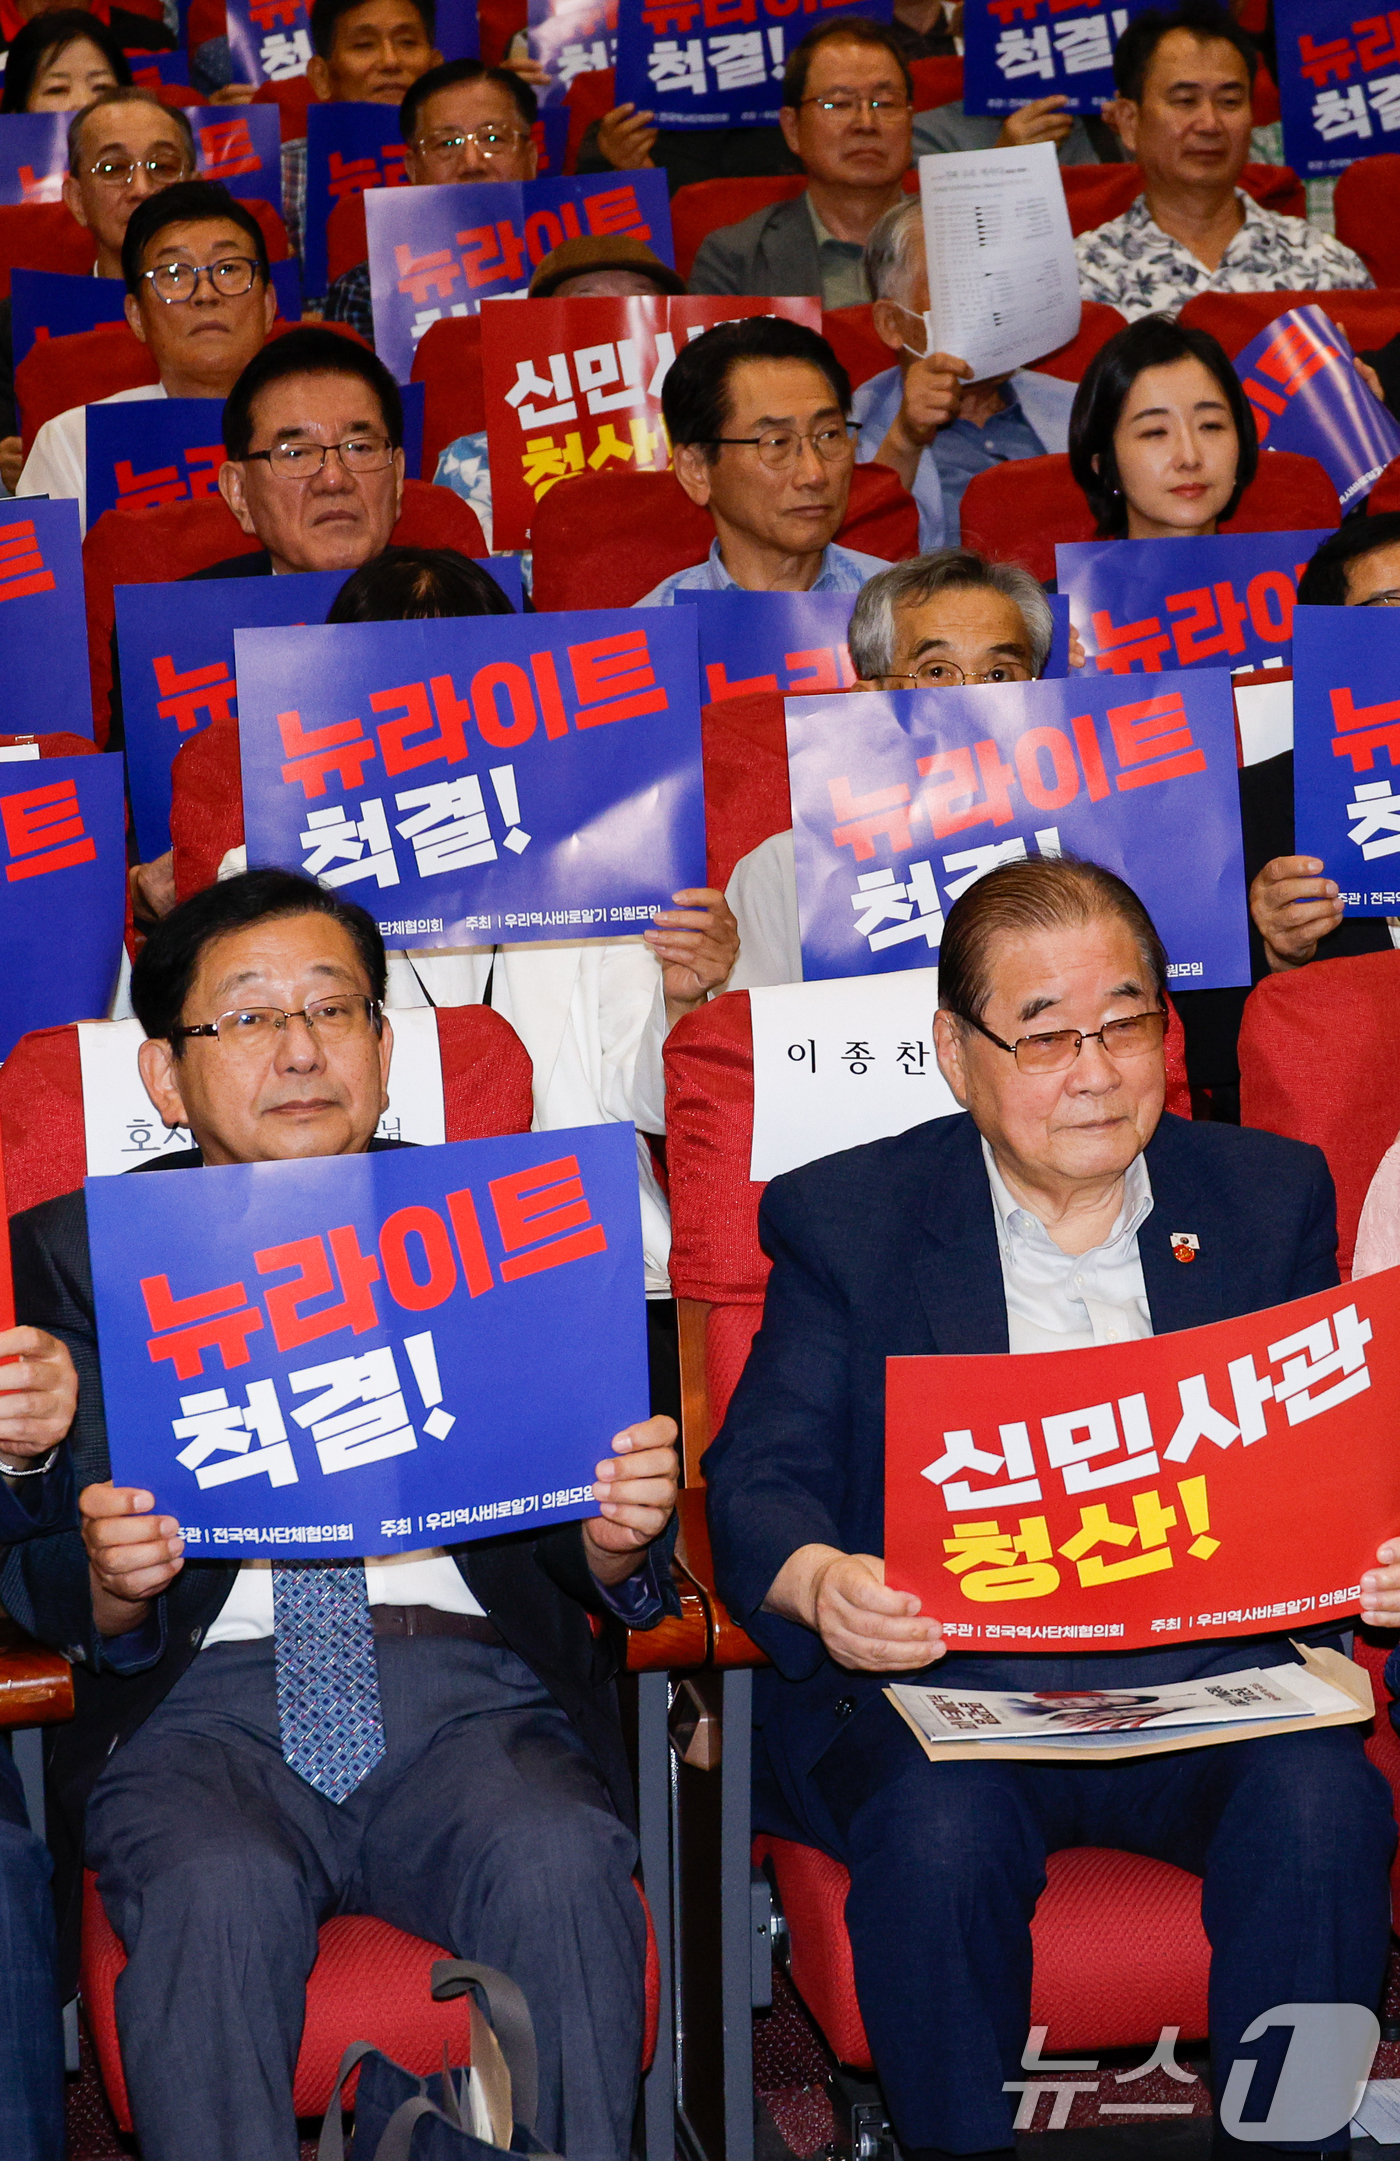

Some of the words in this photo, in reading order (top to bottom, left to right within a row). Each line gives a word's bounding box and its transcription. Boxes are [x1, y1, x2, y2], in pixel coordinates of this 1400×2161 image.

[648, 26, 786, 95] 척결!
[394, 185, 651, 304] 뉴라이트
[276, 629, 669, 799] 뉴라이트
[300, 764, 532, 889] 척결!
[827, 692, 1207, 862] 뉴라이트
[376, 918, 444, 936] 단체협의회
[465, 914, 492, 931] 주최
[504, 907, 608, 928] 우리역사바로알기
[610, 904, 662, 922] 의원모임
[376, 1116, 402, 1141] 님
[140, 1154, 608, 1381] 뉴라이트
[171, 1330, 457, 1490] 척결!
[919, 1303, 1374, 1512] 신민사관
[212, 1523, 354, 1544] 전국역사단체협의회
[380, 1516, 412, 1538] 주최
[425, 1494, 540, 1532] 우리역사바로알기
[941, 1474, 1222, 1602] 청산!
[942, 1622, 974, 1638] 주관
[985, 1623, 1125, 1639] 전국역사단체협의회
[1150, 1616, 1181, 1633] 주최
[1196, 1596, 1316, 1627] 우리역사바로알기
